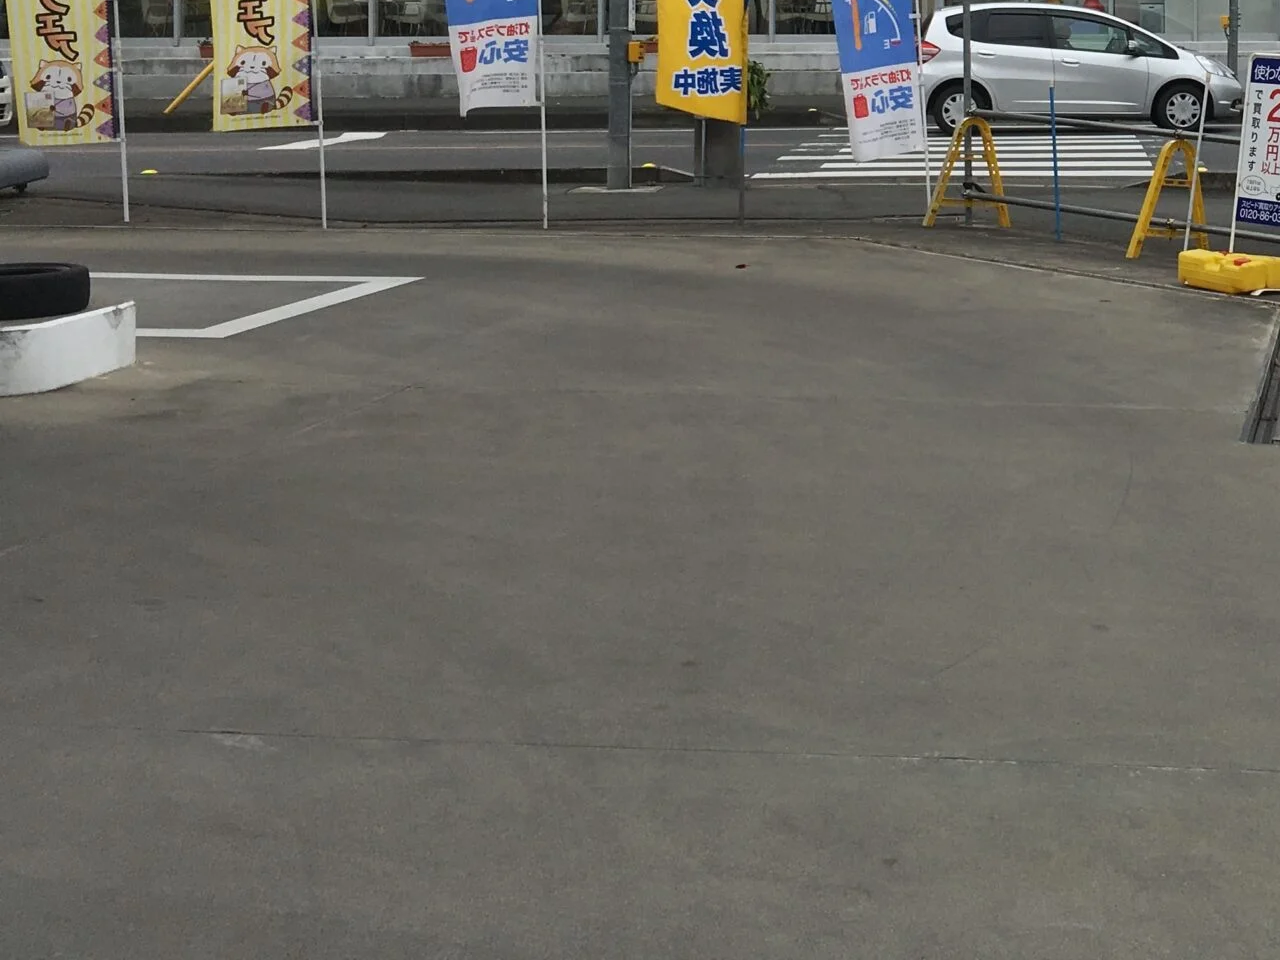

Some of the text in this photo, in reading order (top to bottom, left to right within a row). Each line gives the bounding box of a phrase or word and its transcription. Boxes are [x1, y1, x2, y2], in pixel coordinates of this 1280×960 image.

[1247, 90, 1264, 172] で買取ります
